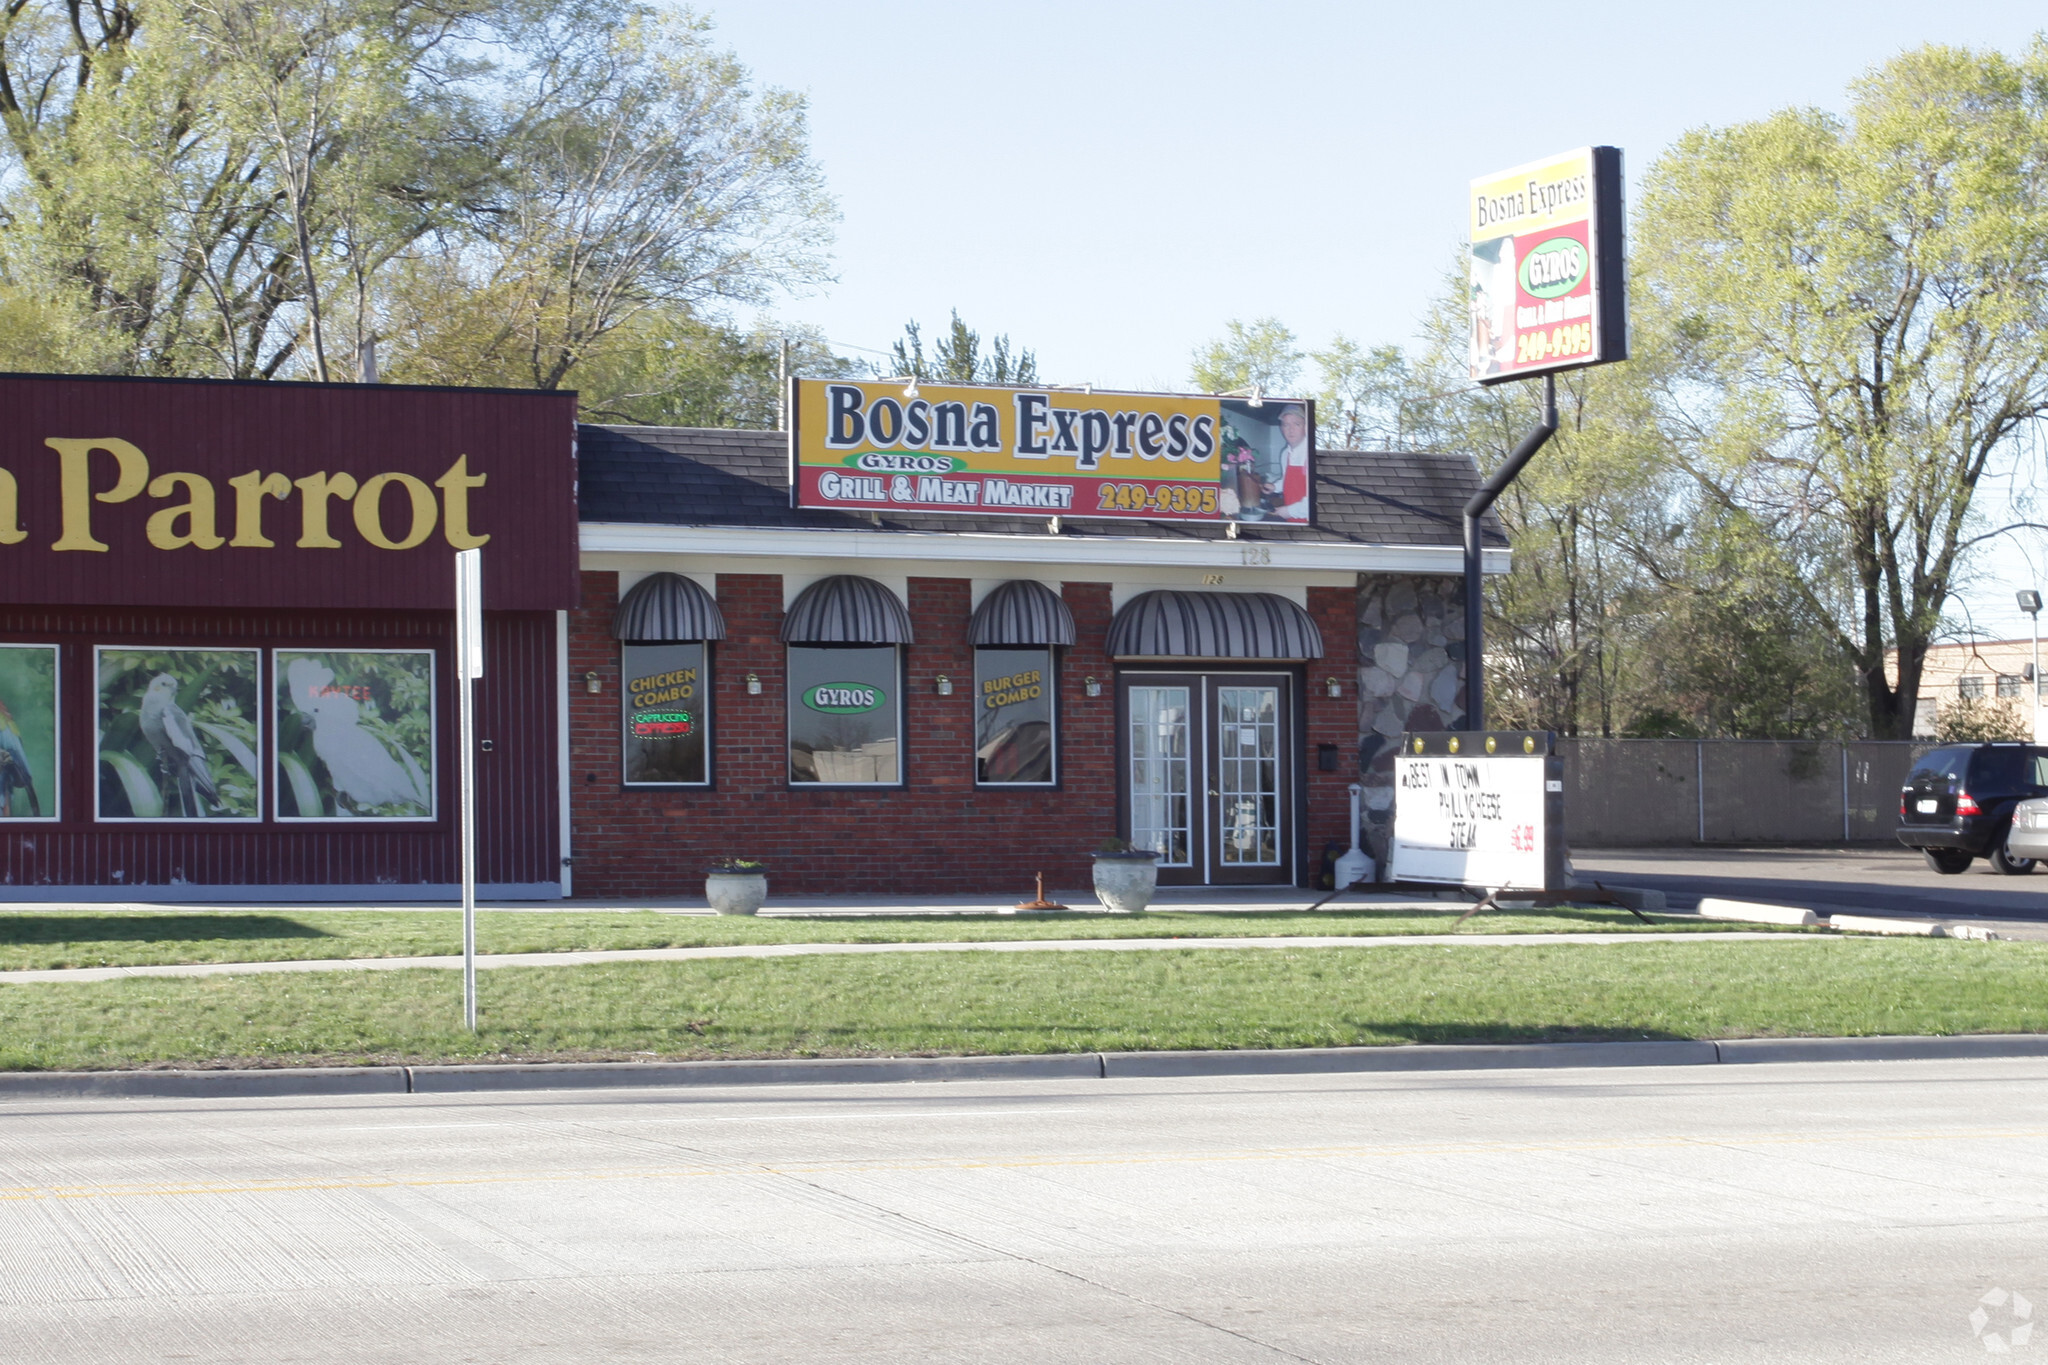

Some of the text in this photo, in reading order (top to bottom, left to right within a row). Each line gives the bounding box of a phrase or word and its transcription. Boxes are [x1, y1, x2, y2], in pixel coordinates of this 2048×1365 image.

[1478, 175, 1585, 227] Bosna Express
[1528, 246, 1580, 290] GYROS
[1516, 322, 1591, 363] 249-9395
[825, 384, 1214, 470] Bosna Express
[858, 453, 953, 474] GYROS
[44, 437, 490, 551] Parrot
[889, 475, 916, 503] &
[1097, 482, 1218, 514] 249-9395
[1241, 547, 1271, 566] 128
[629, 668, 697, 693] CHICKEN
[982, 670, 1041, 694] BURGER
[633, 685, 694, 708] COMBO
[815, 687, 876, 708] GYROS
[985, 685, 1042, 709] COMBO
[1409, 763, 1432, 789] BEST
[1454, 763, 1481, 790] TOWN
